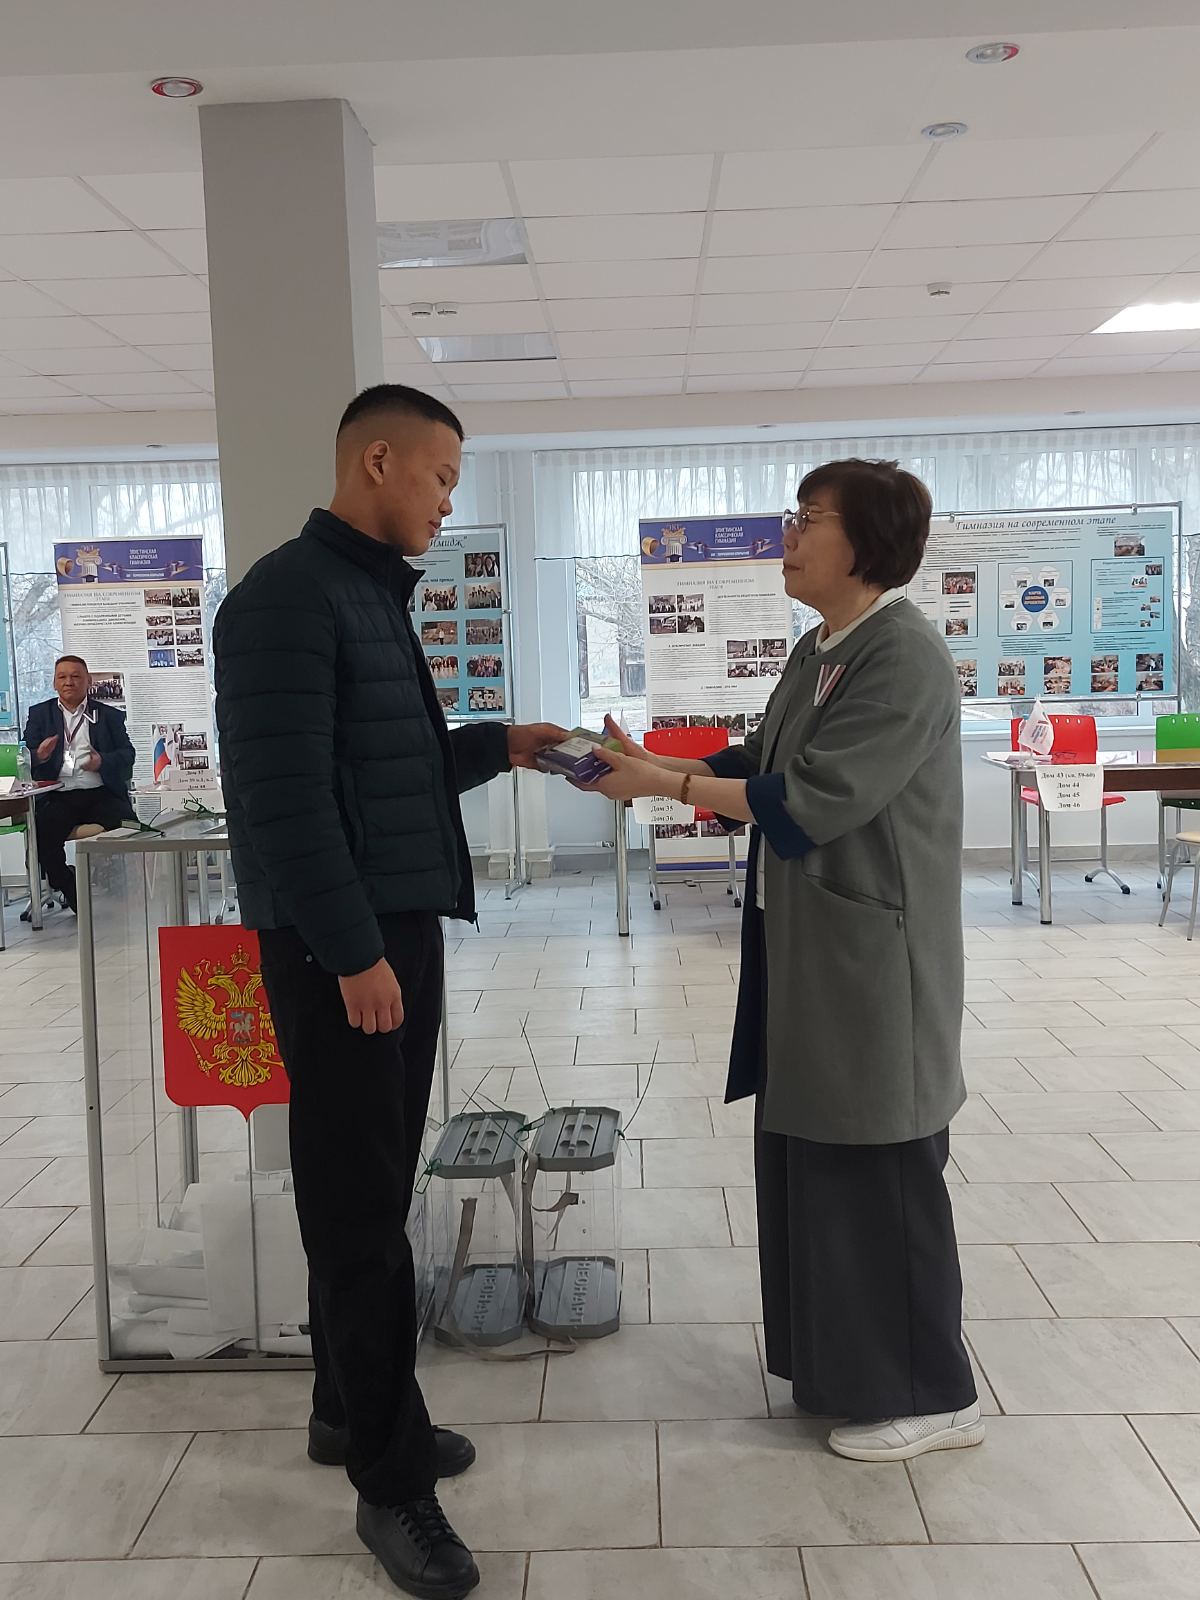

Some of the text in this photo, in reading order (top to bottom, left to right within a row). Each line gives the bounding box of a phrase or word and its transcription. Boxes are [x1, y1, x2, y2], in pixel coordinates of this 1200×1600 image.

[955, 521, 1004, 531] Гимназия
[1021, 518, 1084, 530] современном
[1086, 516, 1117, 525] этапе
